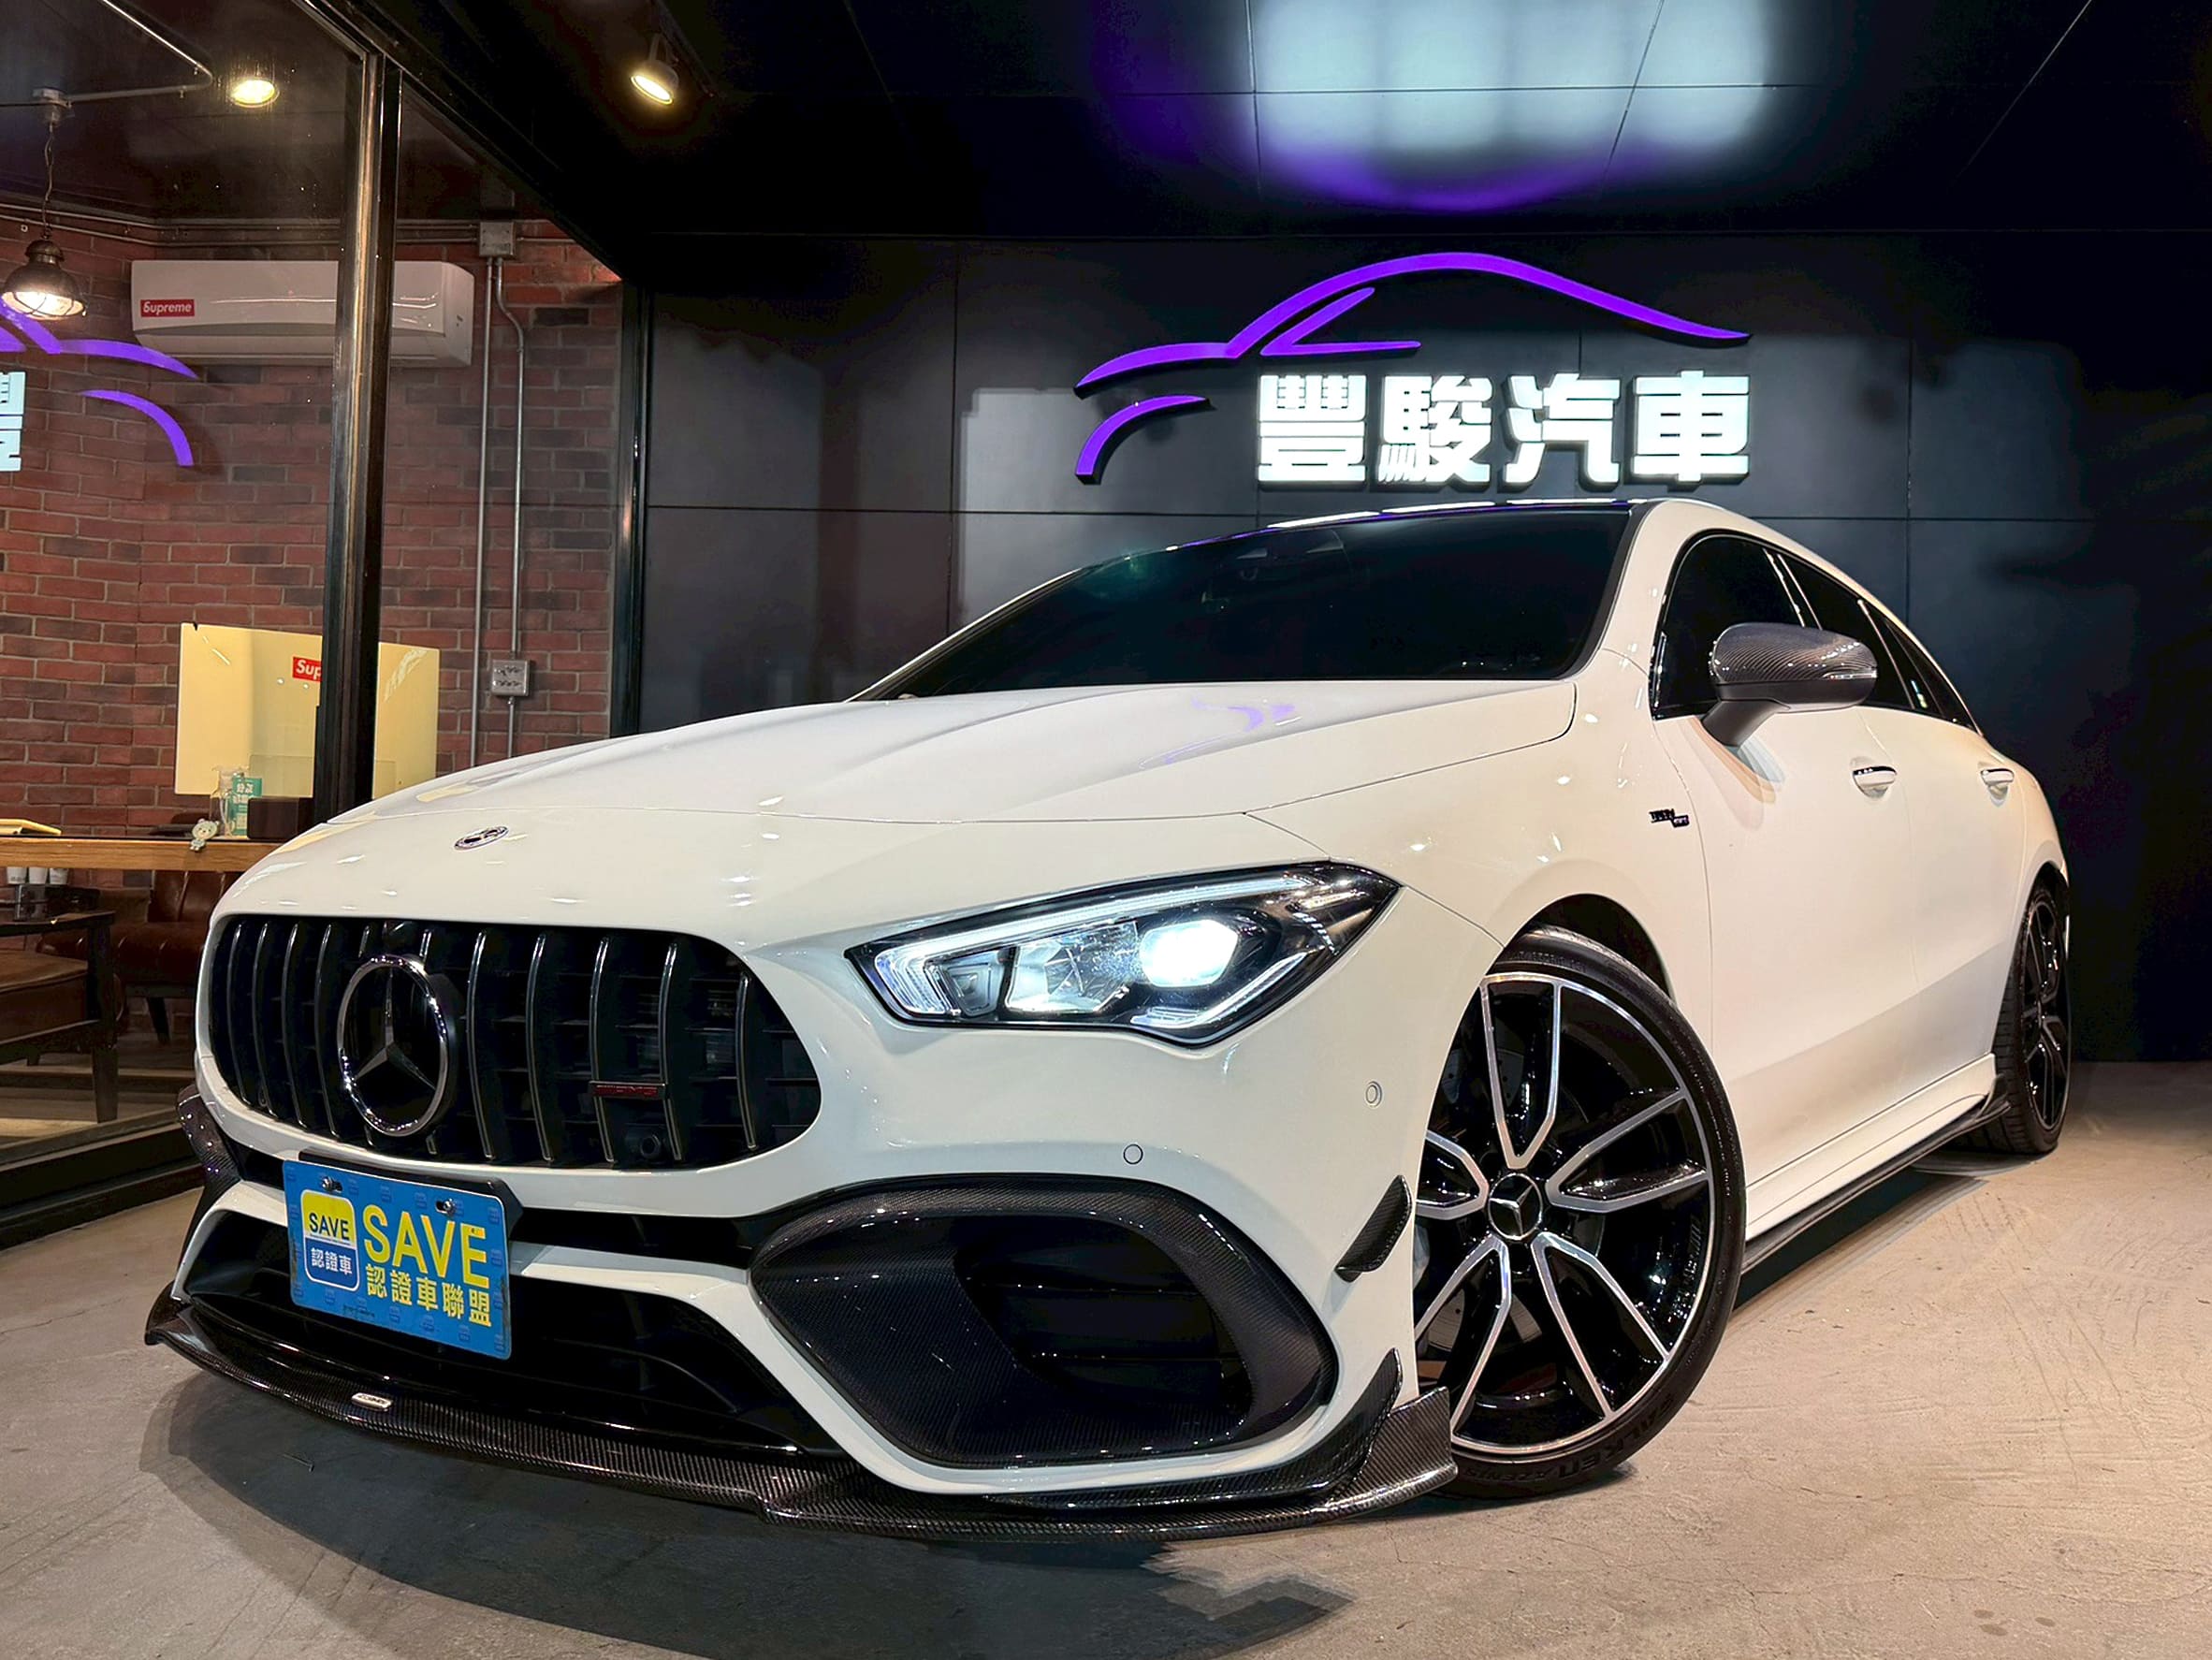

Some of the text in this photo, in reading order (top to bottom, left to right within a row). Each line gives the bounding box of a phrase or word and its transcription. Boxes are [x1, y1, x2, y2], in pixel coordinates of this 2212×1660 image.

[143, 300, 192, 315] Supreme
[1259, 371, 1751, 484] 豐駿汽車
[309, 1212, 350, 1241] SAVE
[362, 1203, 489, 1289] SAVE
[311, 1246, 353, 1275] 認證車
[365, 1263, 492, 1327] 認證車聯盟
